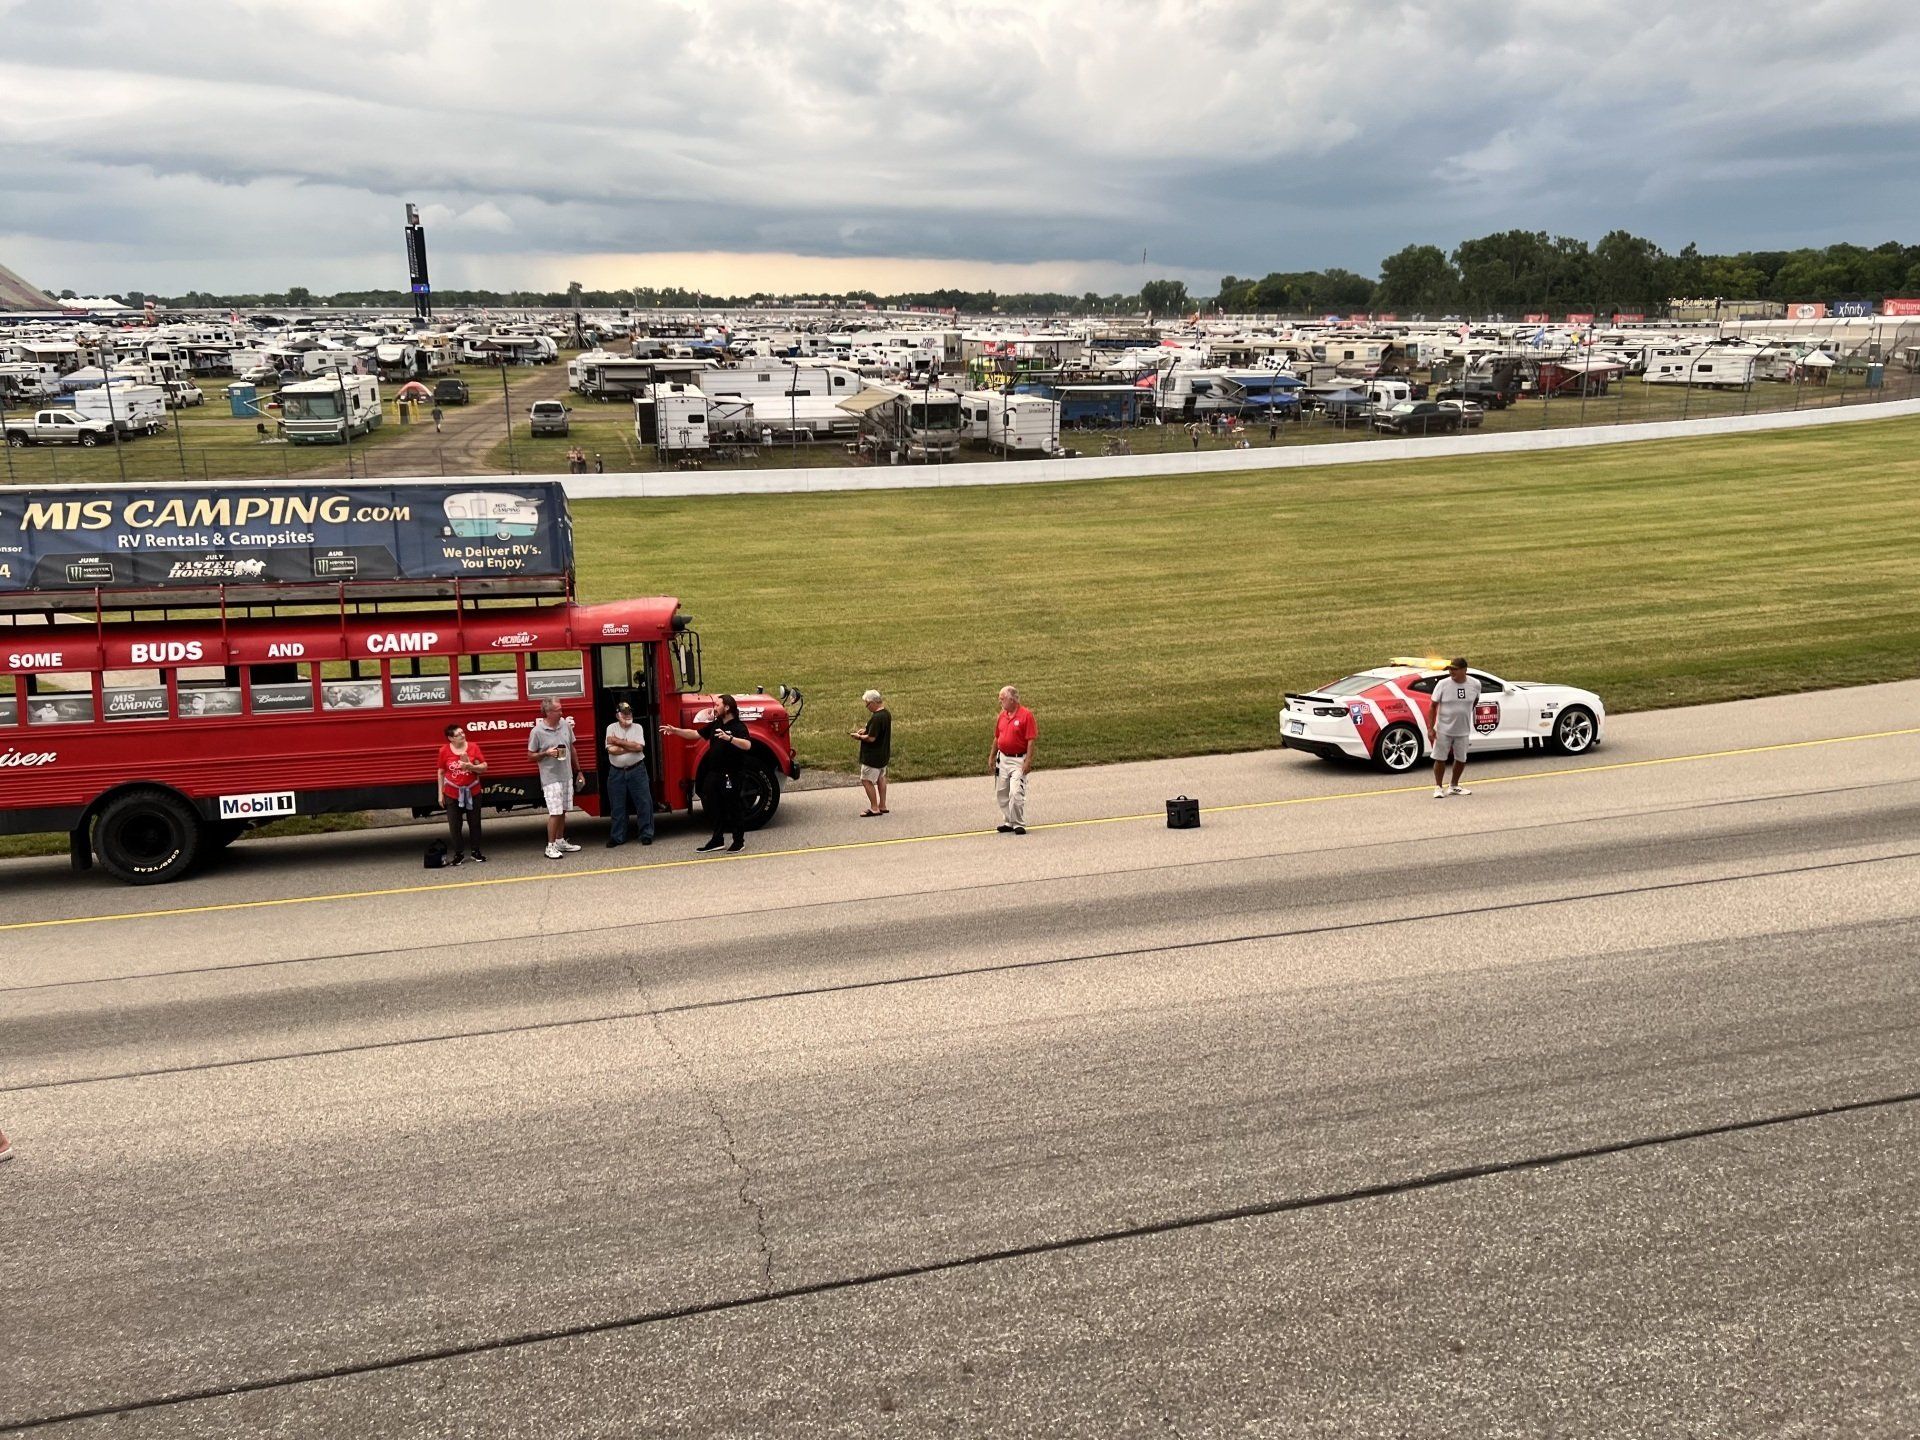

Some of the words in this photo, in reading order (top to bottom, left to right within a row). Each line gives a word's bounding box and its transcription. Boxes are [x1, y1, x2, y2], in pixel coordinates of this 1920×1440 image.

[1839, 303, 1866, 318] xfinity
[20, 501, 112, 531] MIS
[118, 535, 141, 548] RV
[146, 533, 208, 547] Rentals
[214, 533, 226, 546] &
[229, 530, 315, 547] Campsites
[442, 547, 462, 558] We
[465, 544, 510, 557] Deliver
[205, 553, 225, 561] JULY
[173, 560, 236, 570] FASTER
[461, 558, 489, 569] You
[488, 556, 525, 570] Enjoy.
[168, 568, 232, 579] HORSES
[498, 635, 530, 646] MICHIGAN
[9, 653, 63, 668] SOME
[132, 641, 203, 663] BUDS
[268, 643, 305, 658] AND
[367, 632, 439, 653] CAMP
[400, 685, 421, 694] MIS
[532, 679, 577, 690] Budweiser
[112, 694, 136, 703] MIS
[256, 694, 306, 704] Budweiser
[397, 692, 446, 702] CAMPING
[109, 701, 163, 711] CAMPING
[466, 720, 508, 731] GRAB
[508, 721, 535, 729] SOME
[223, 799, 273, 814] Mobil
